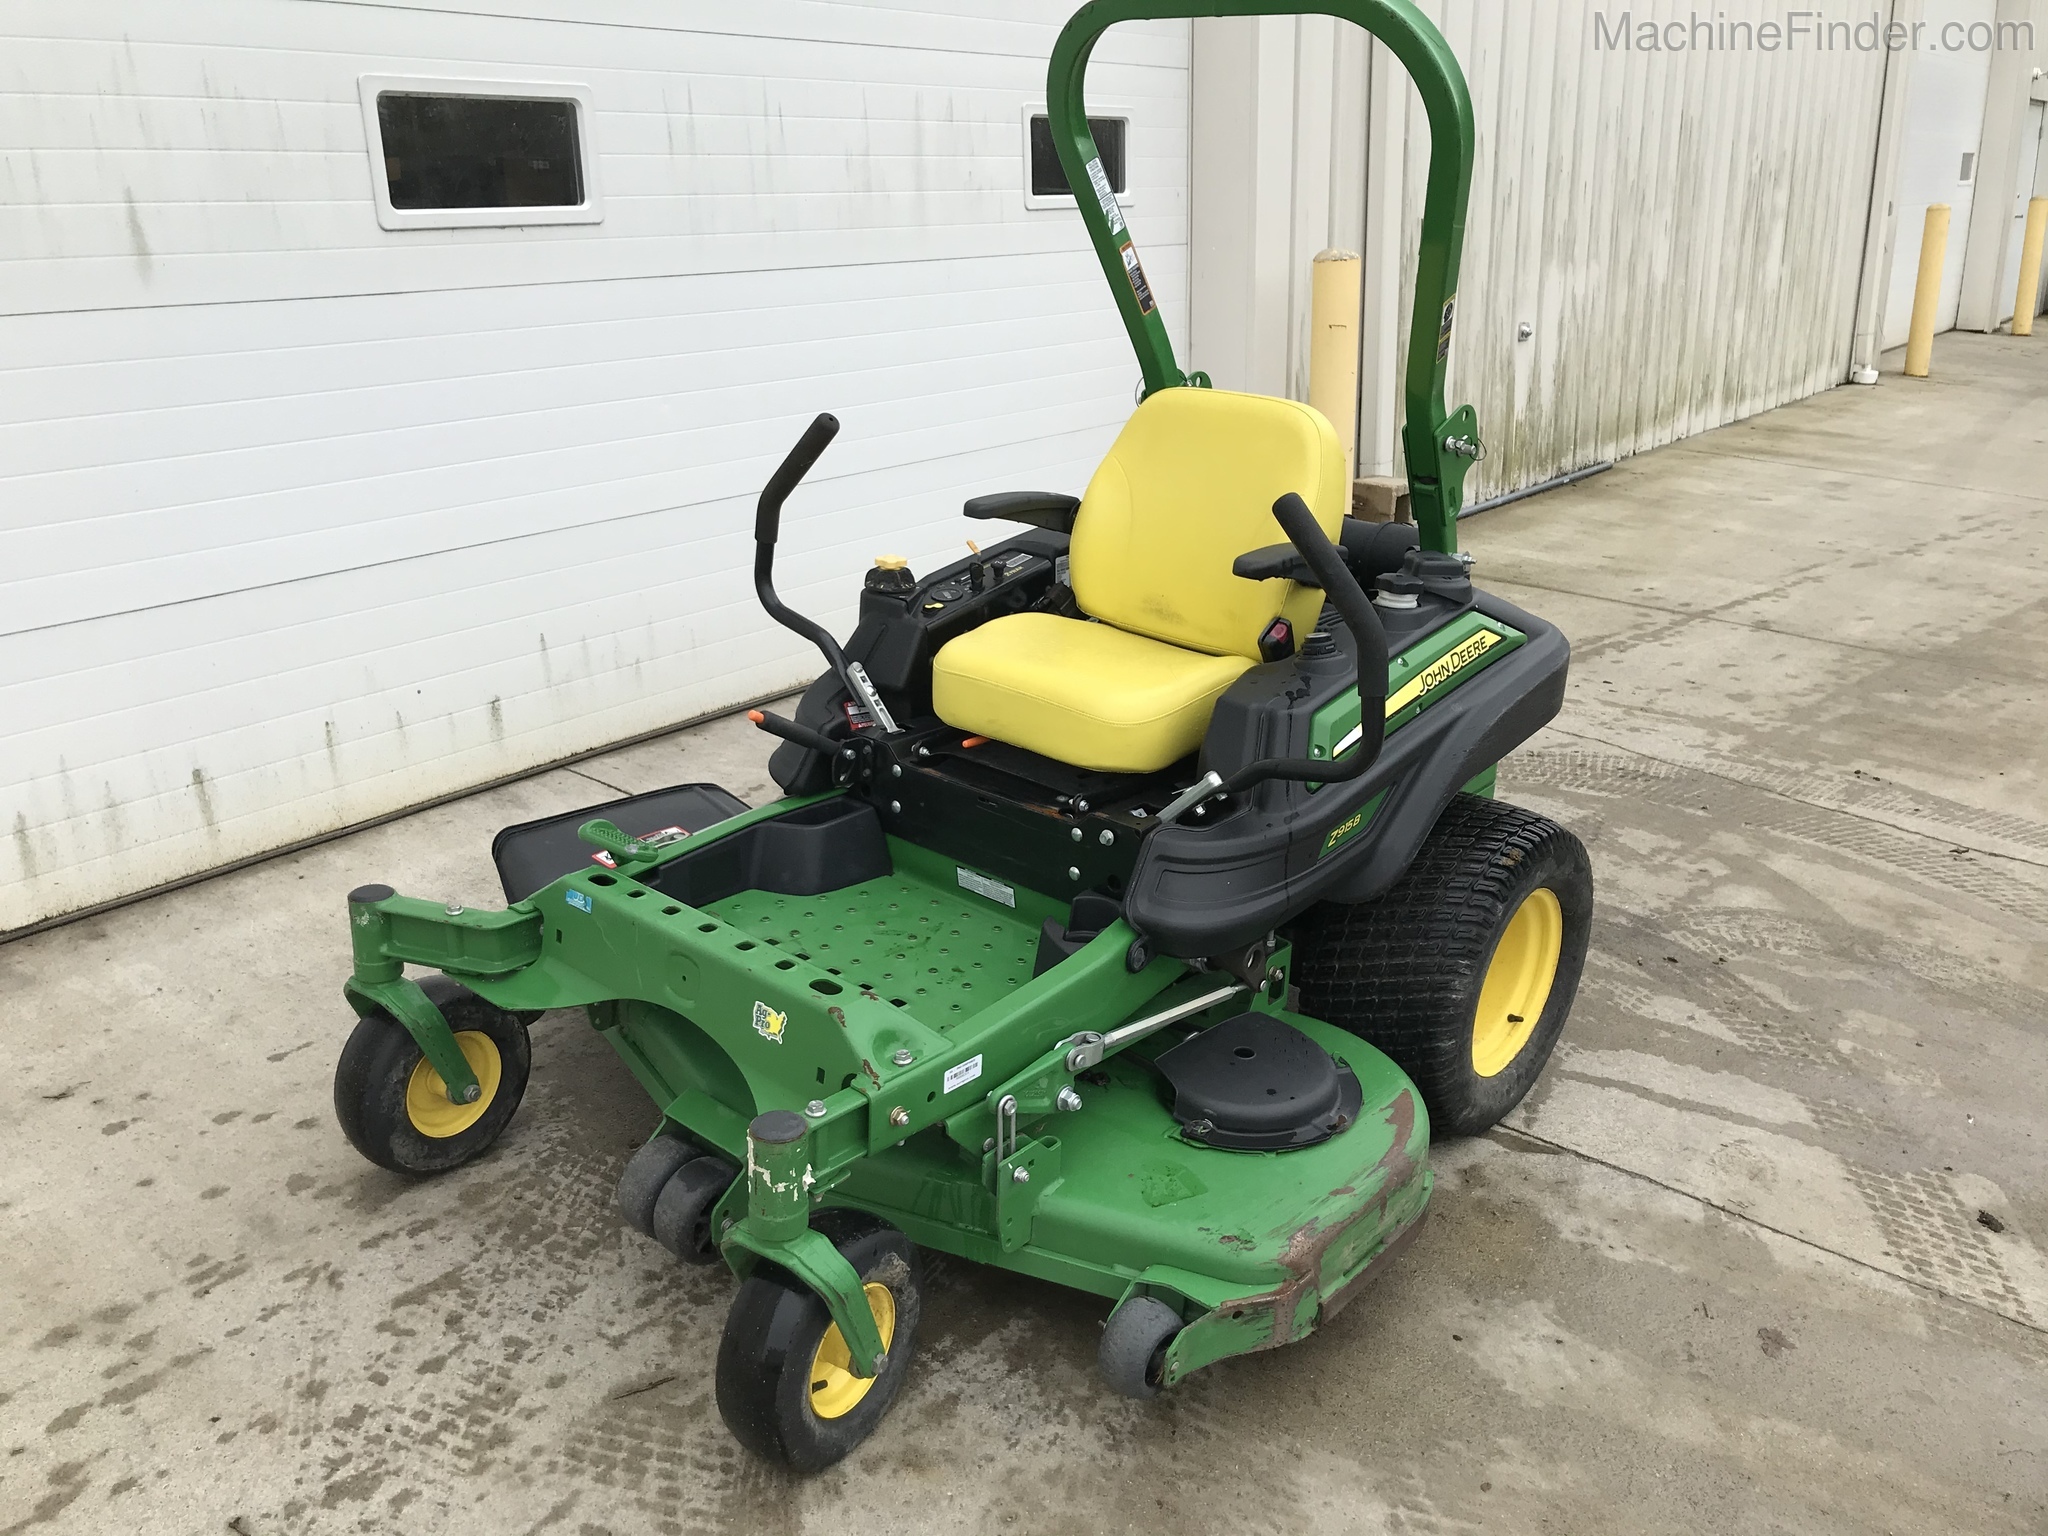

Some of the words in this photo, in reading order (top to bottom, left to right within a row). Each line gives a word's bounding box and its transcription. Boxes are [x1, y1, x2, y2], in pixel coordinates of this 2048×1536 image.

[1420, 661, 1451, 694] JOHN
[1450, 636, 1488, 669] DEERE
[1327, 813, 1361, 848] Z915B
